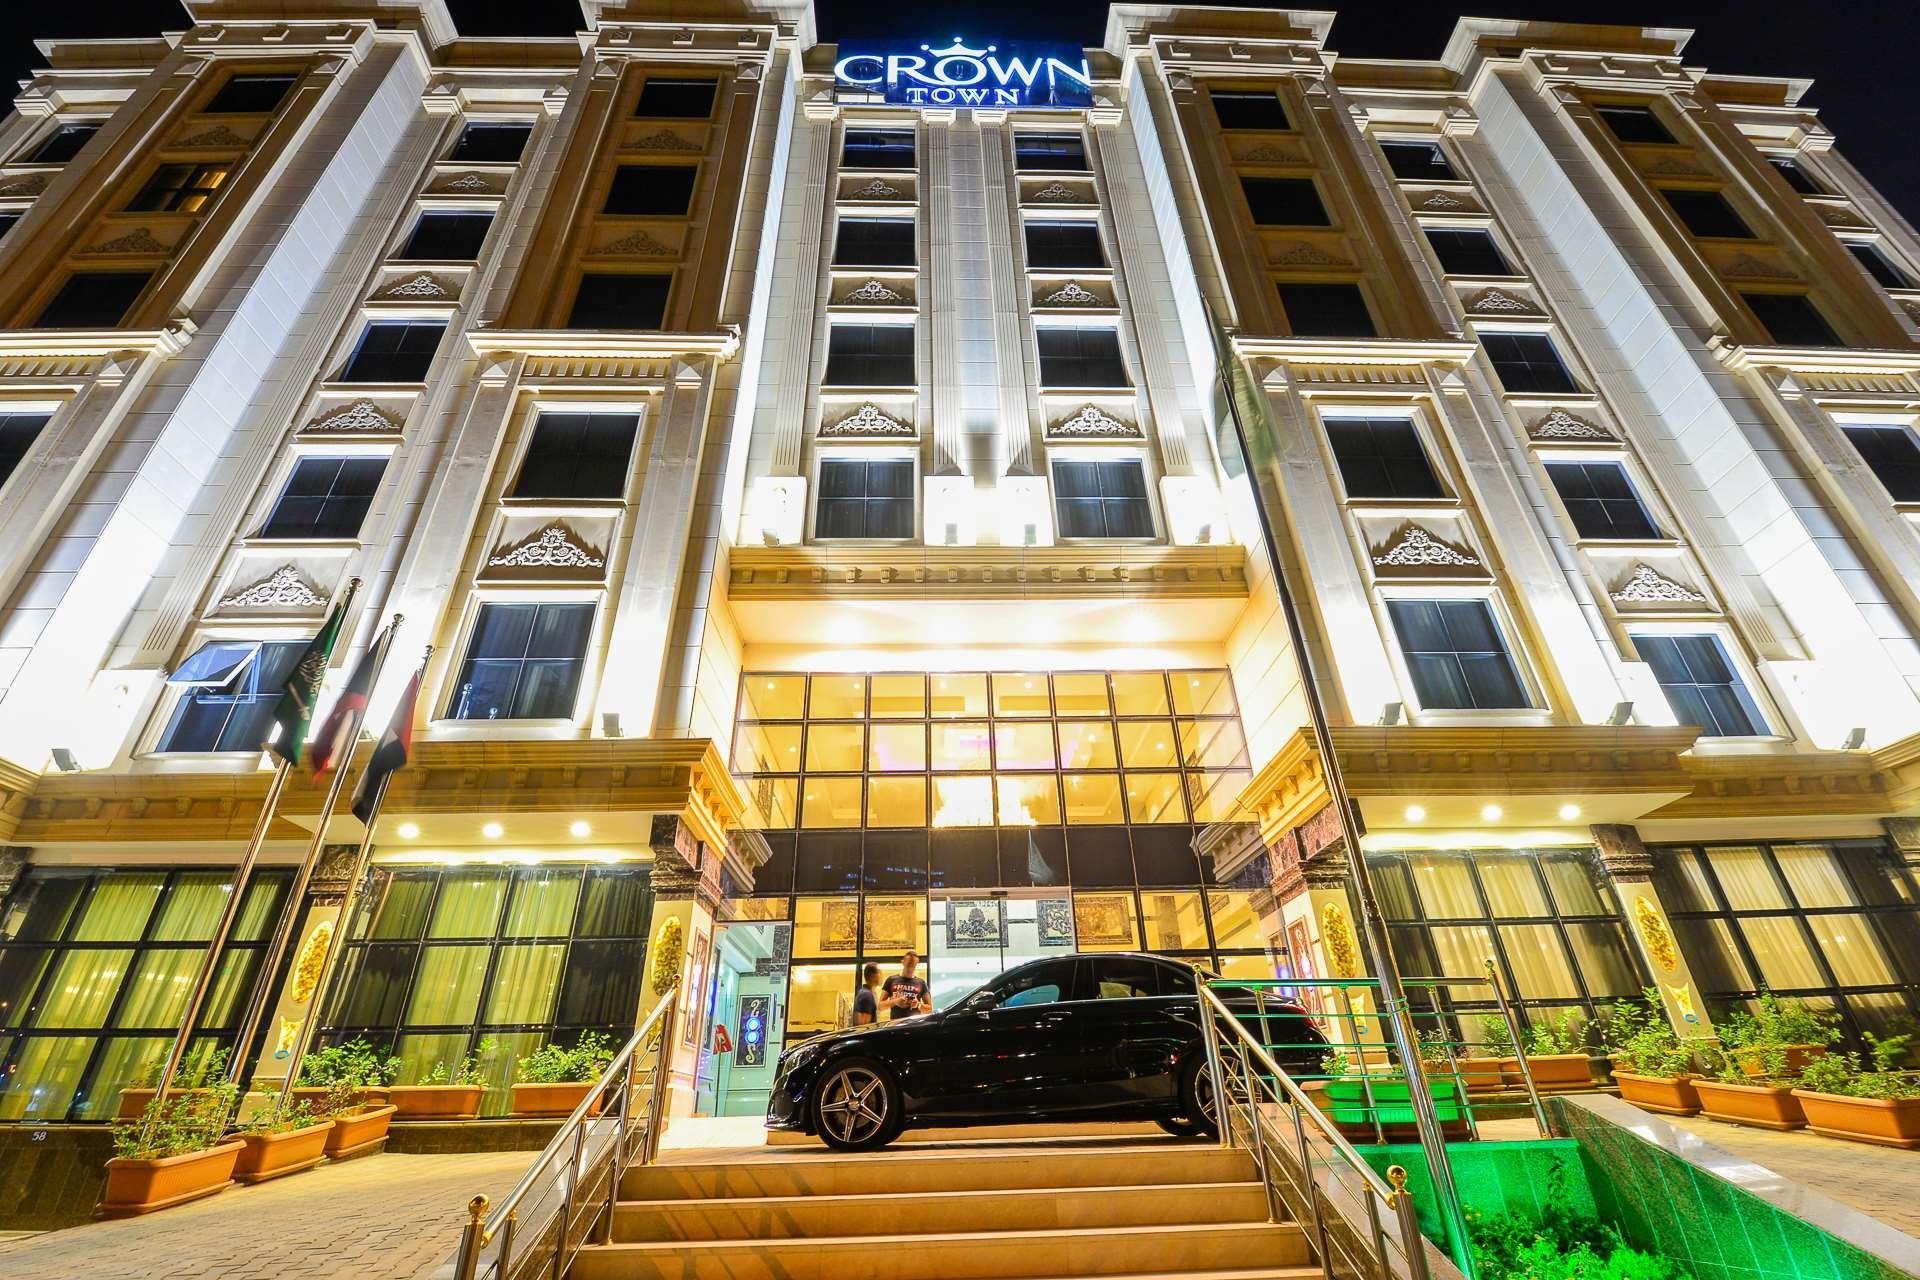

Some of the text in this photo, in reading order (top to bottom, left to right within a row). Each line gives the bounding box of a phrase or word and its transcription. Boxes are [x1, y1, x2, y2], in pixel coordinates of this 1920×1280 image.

[834, 55, 1091, 87] CROWN
[906, 87, 1020, 105] TOWN
[32, 1131, 47, 1141] 58
